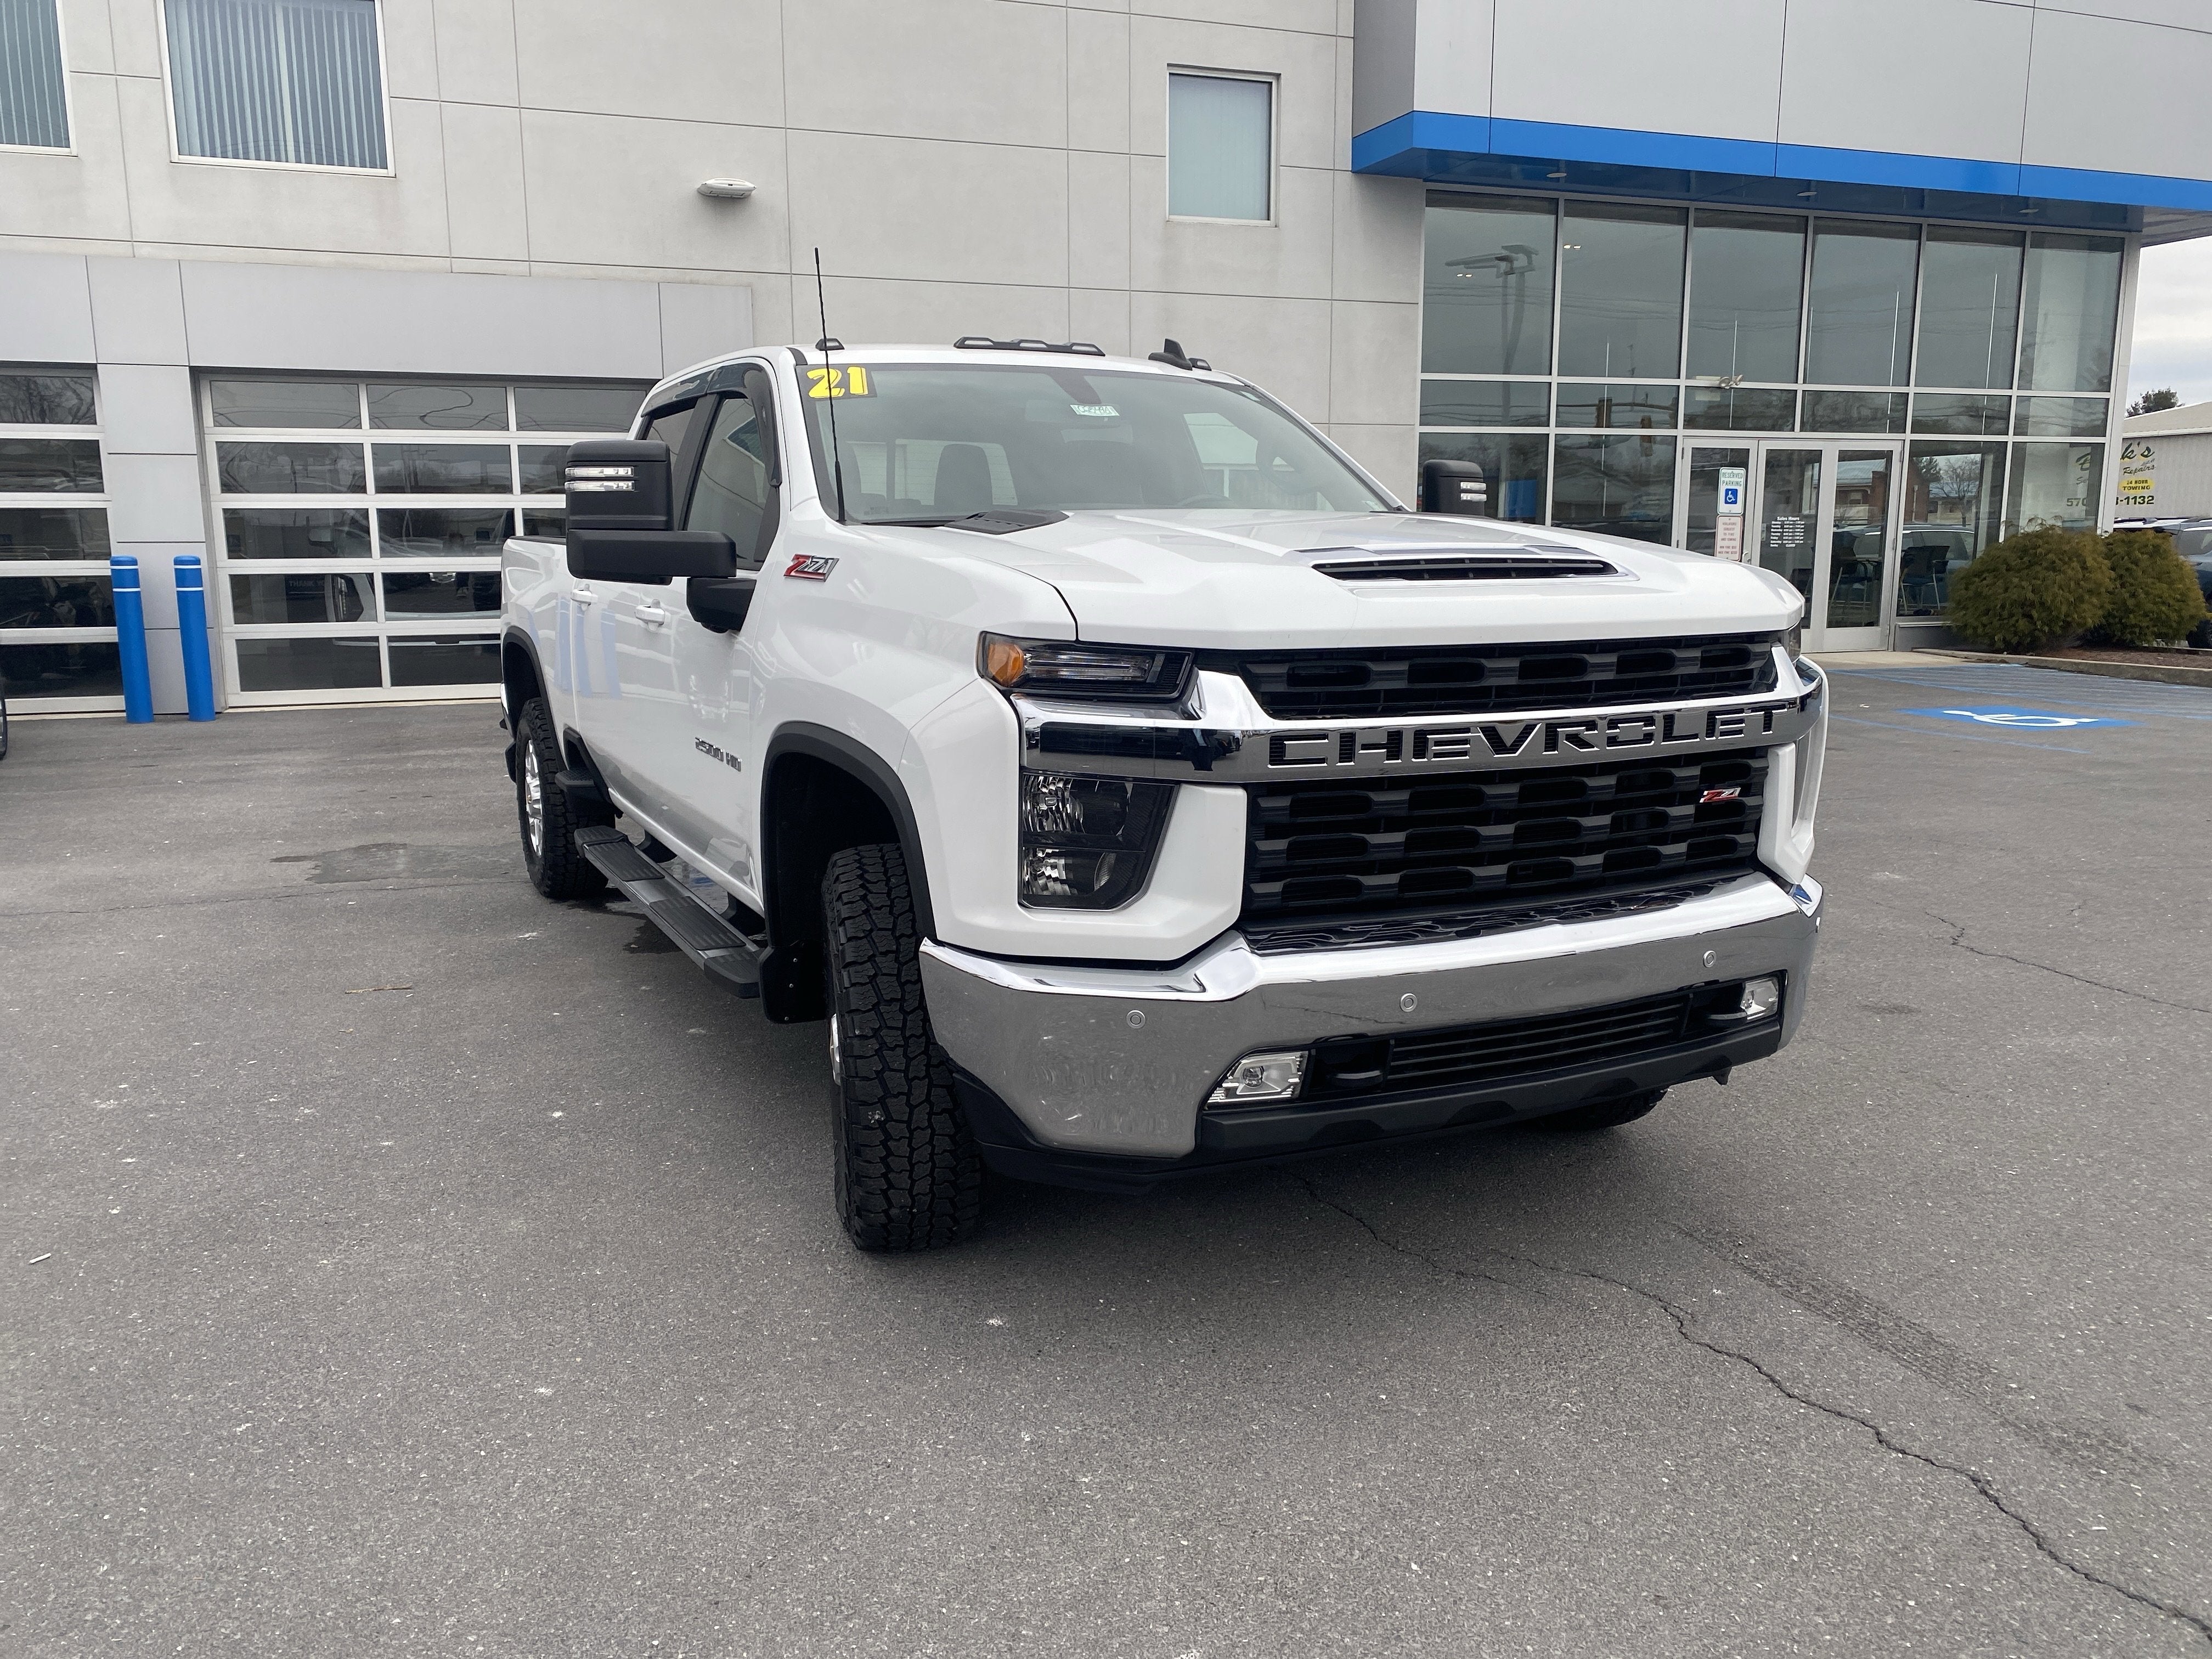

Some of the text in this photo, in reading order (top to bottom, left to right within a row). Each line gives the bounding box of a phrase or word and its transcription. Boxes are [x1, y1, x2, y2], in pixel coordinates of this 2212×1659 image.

[806, 366, 868, 398] 21
[2123, 465, 2155, 476] Repairs
[783, 554, 839, 582] Z71
[1267, 707, 1788, 769] CHEVROLET
[725, 752, 742, 772] HD
[1699, 787, 1741, 803] Z71
